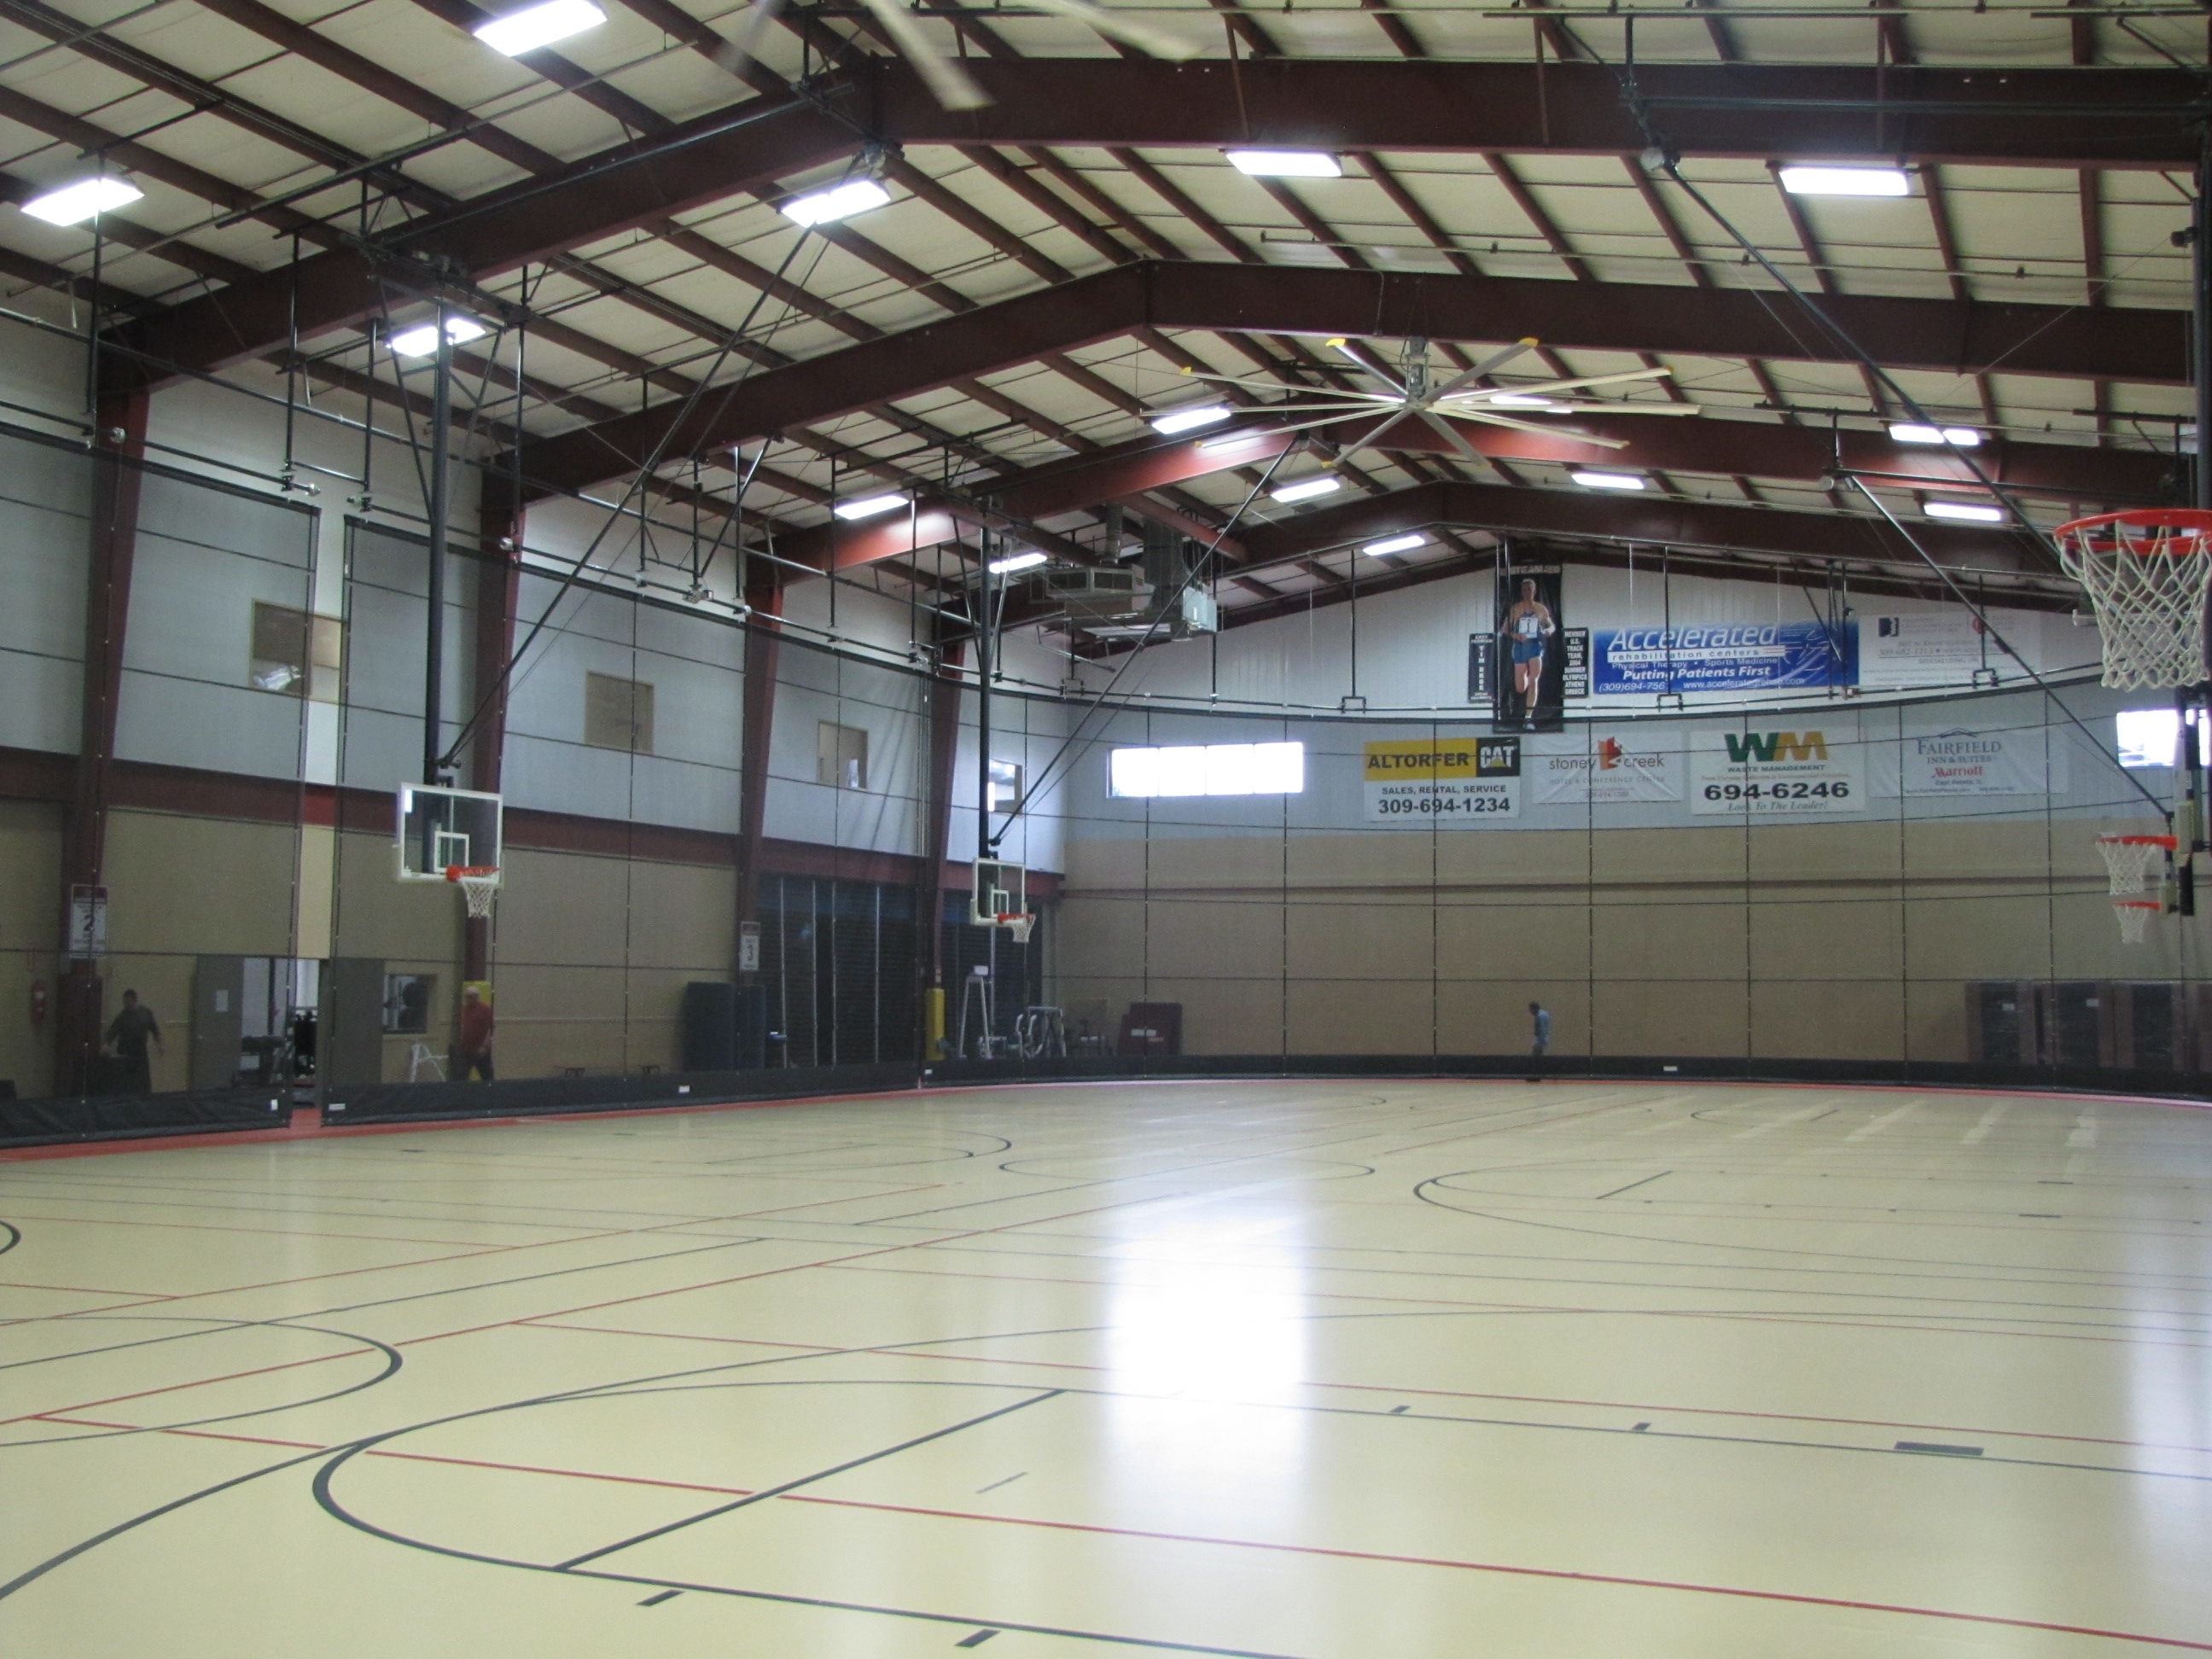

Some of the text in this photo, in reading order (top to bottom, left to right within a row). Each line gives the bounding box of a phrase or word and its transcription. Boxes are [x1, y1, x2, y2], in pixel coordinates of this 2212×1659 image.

[1608, 626, 1778, 650] Accelerated
[1708, 649, 1759, 657] centers
[1612, 661, 1648, 670] Physical
[1652, 661, 1687, 669] Therapy
[1623, 666, 1771, 681] Putting Patients First
[1724, 731, 1828, 762] WM
[1918, 738, 2001, 754] FAIRFIELD
[1368, 746, 1515, 769] ALTORFER CAT
[1550, 757, 1664, 770] stoney creek
[1930, 766, 1983, 778] Marriott
[1382, 784, 1506, 795] SALES, RENTAL, SERVICE
[1704, 781, 1849, 800] 694-6246
[1378, 797, 1511, 814] 309-694-1234
[1771, 801, 1787, 810] The
[1790, 800, 1827, 809] Leader!
